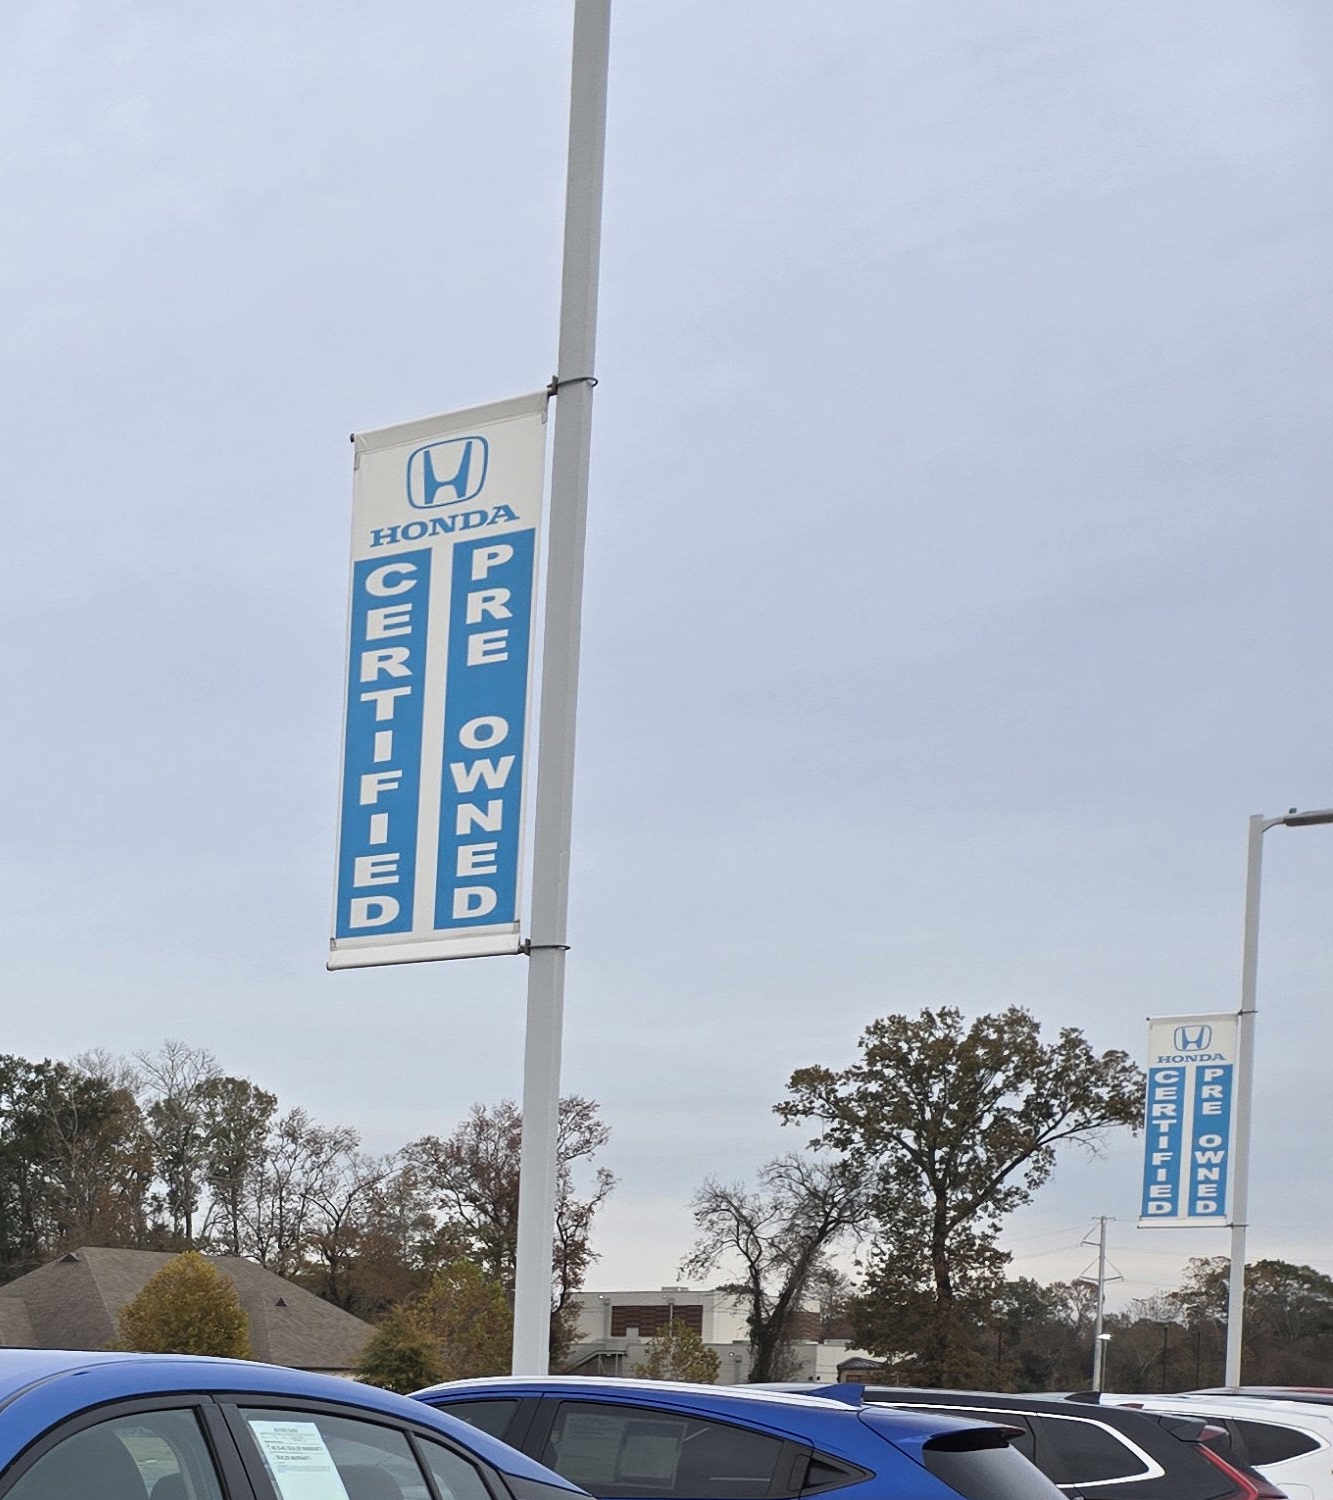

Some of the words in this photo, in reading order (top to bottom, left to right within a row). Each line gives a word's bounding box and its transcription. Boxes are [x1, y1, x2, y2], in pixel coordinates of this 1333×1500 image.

[370, 504, 520, 547] HONDA
[464, 543, 515, 667] PRE
[348, 561, 419, 930] CERTIFIED
[449, 714, 516, 920] OWNED
[1156, 1052, 1226, 1064] HONDA
[1201, 1068, 1225, 1115] PRE
[1148, 1070, 1180, 1214] CERTIFIED
[1194, 1133, 1225, 1214] OWNED
